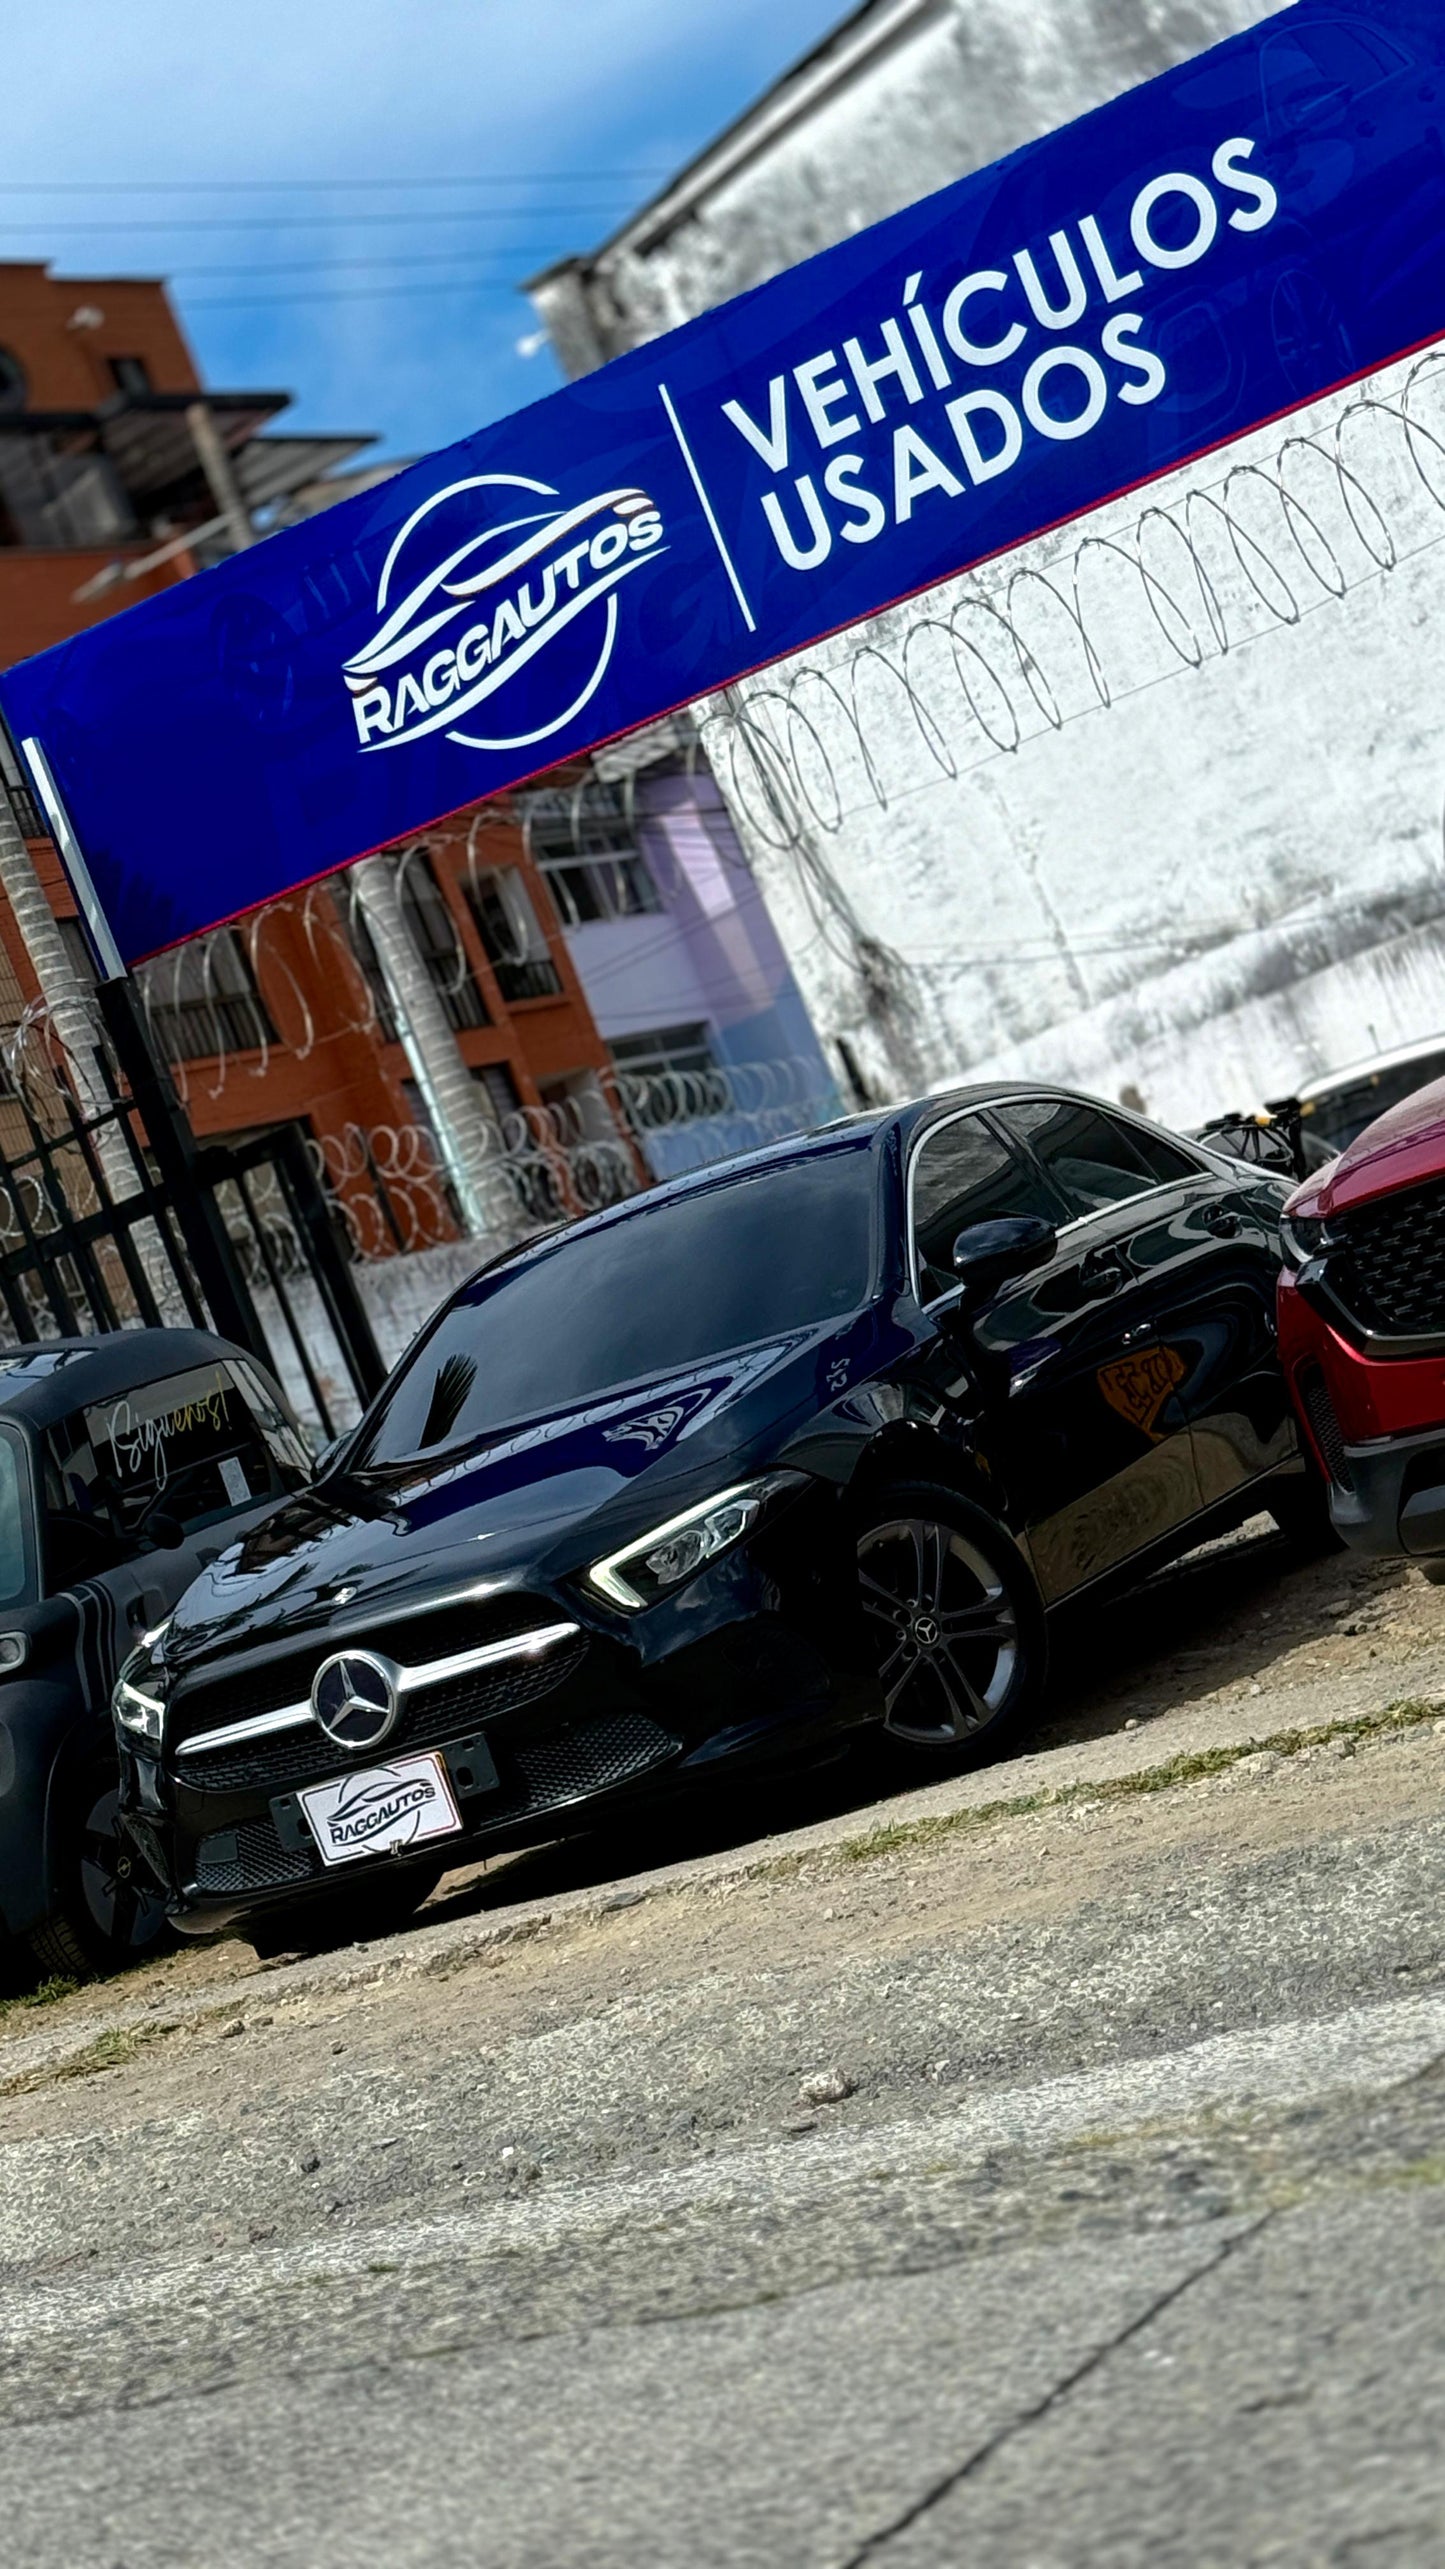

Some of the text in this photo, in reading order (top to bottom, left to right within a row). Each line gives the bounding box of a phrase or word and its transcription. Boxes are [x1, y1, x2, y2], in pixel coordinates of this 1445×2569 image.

[722, 138, 1277, 473] VEHÍCULOS
[761, 314, 1166, 570] USADOS
[352, 511, 663, 743] RAGGAUTOS
[330, 1787, 436, 1843] RAGGAUTOS
